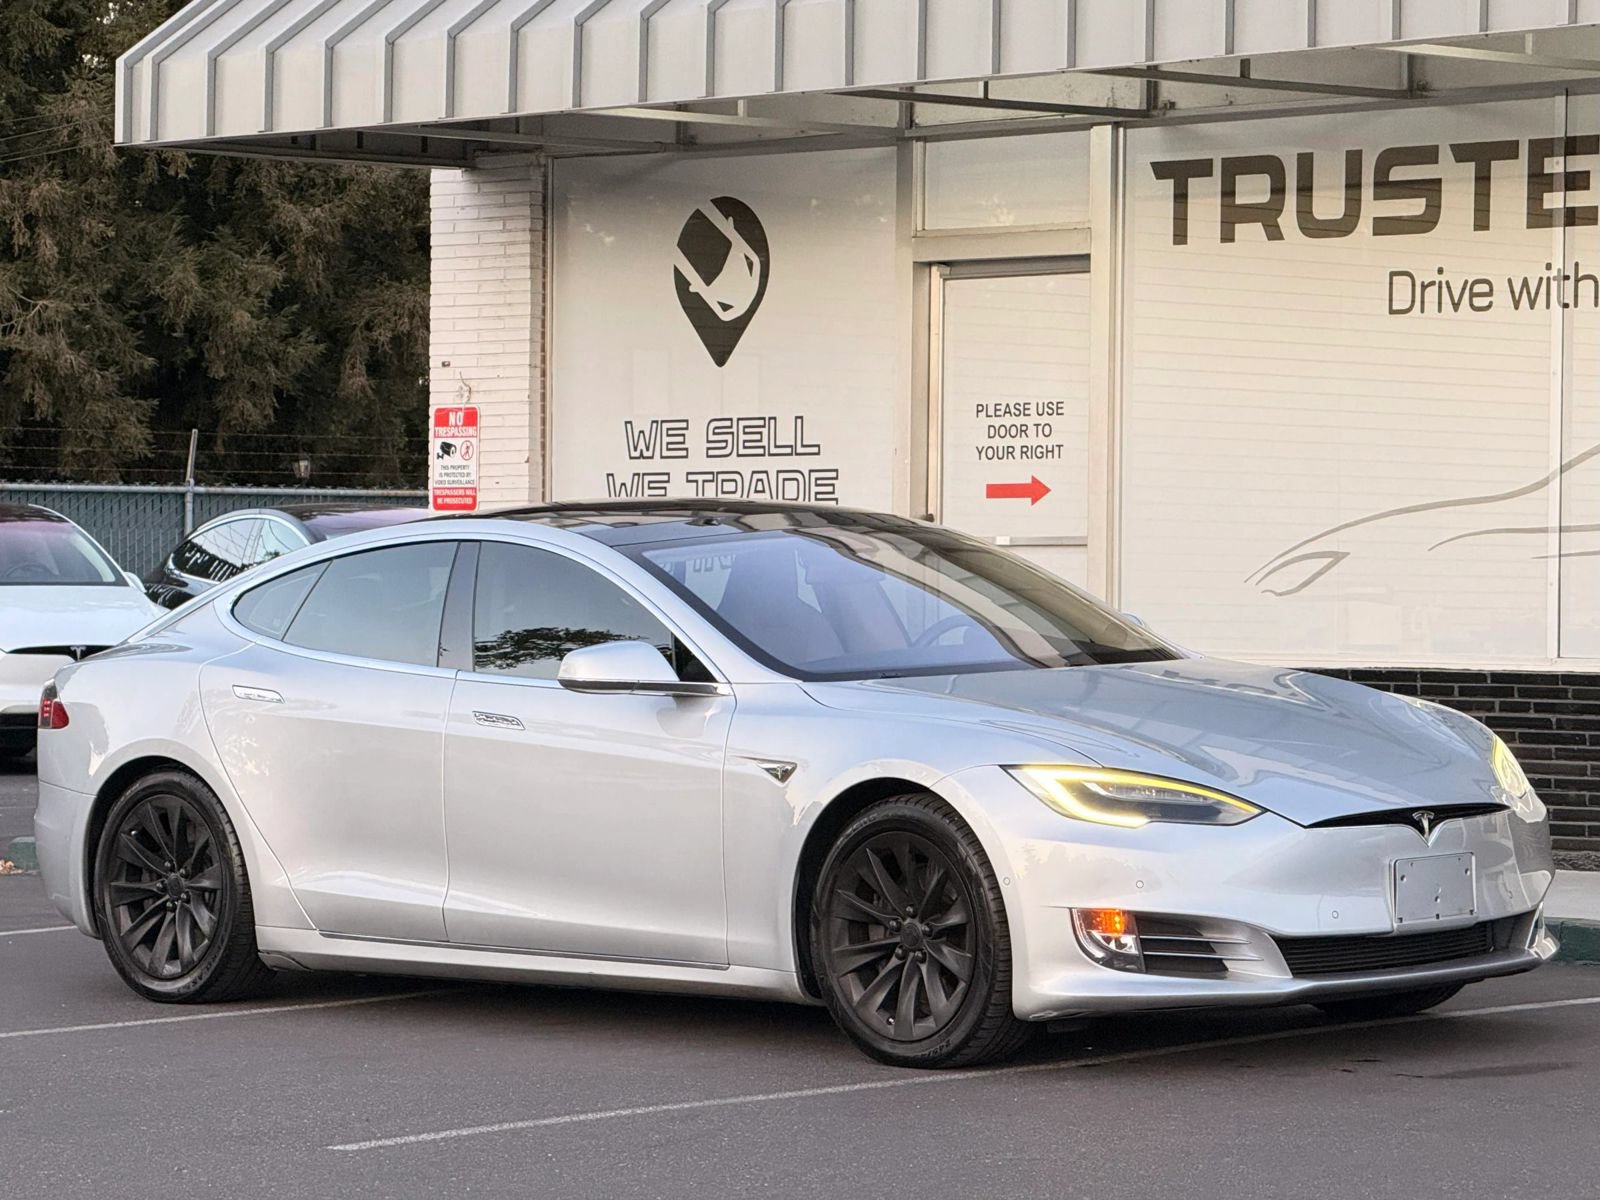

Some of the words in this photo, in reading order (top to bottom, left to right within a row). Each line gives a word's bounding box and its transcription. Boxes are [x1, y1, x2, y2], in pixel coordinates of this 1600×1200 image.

[1149, 134, 1600, 246] TRUSTE
[1388, 266, 1494, 316] Drive
[1507, 260, 1599, 311] with
[975, 402, 1032, 418] PLEASE
[1036, 401, 1065, 416] USE
[448, 411, 464, 426] NO
[434, 426, 478, 437] TRESPASSING
[624, 418, 689, 460] WE
[705, 415, 821, 459] SELL
[987, 423, 1029, 439] DOOR
[1033, 422, 1053, 438] TO
[975, 445, 1016, 461] YOUR
[1020, 444, 1064, 460] RIGHT
[685, 468, 839, 505] TRADE
